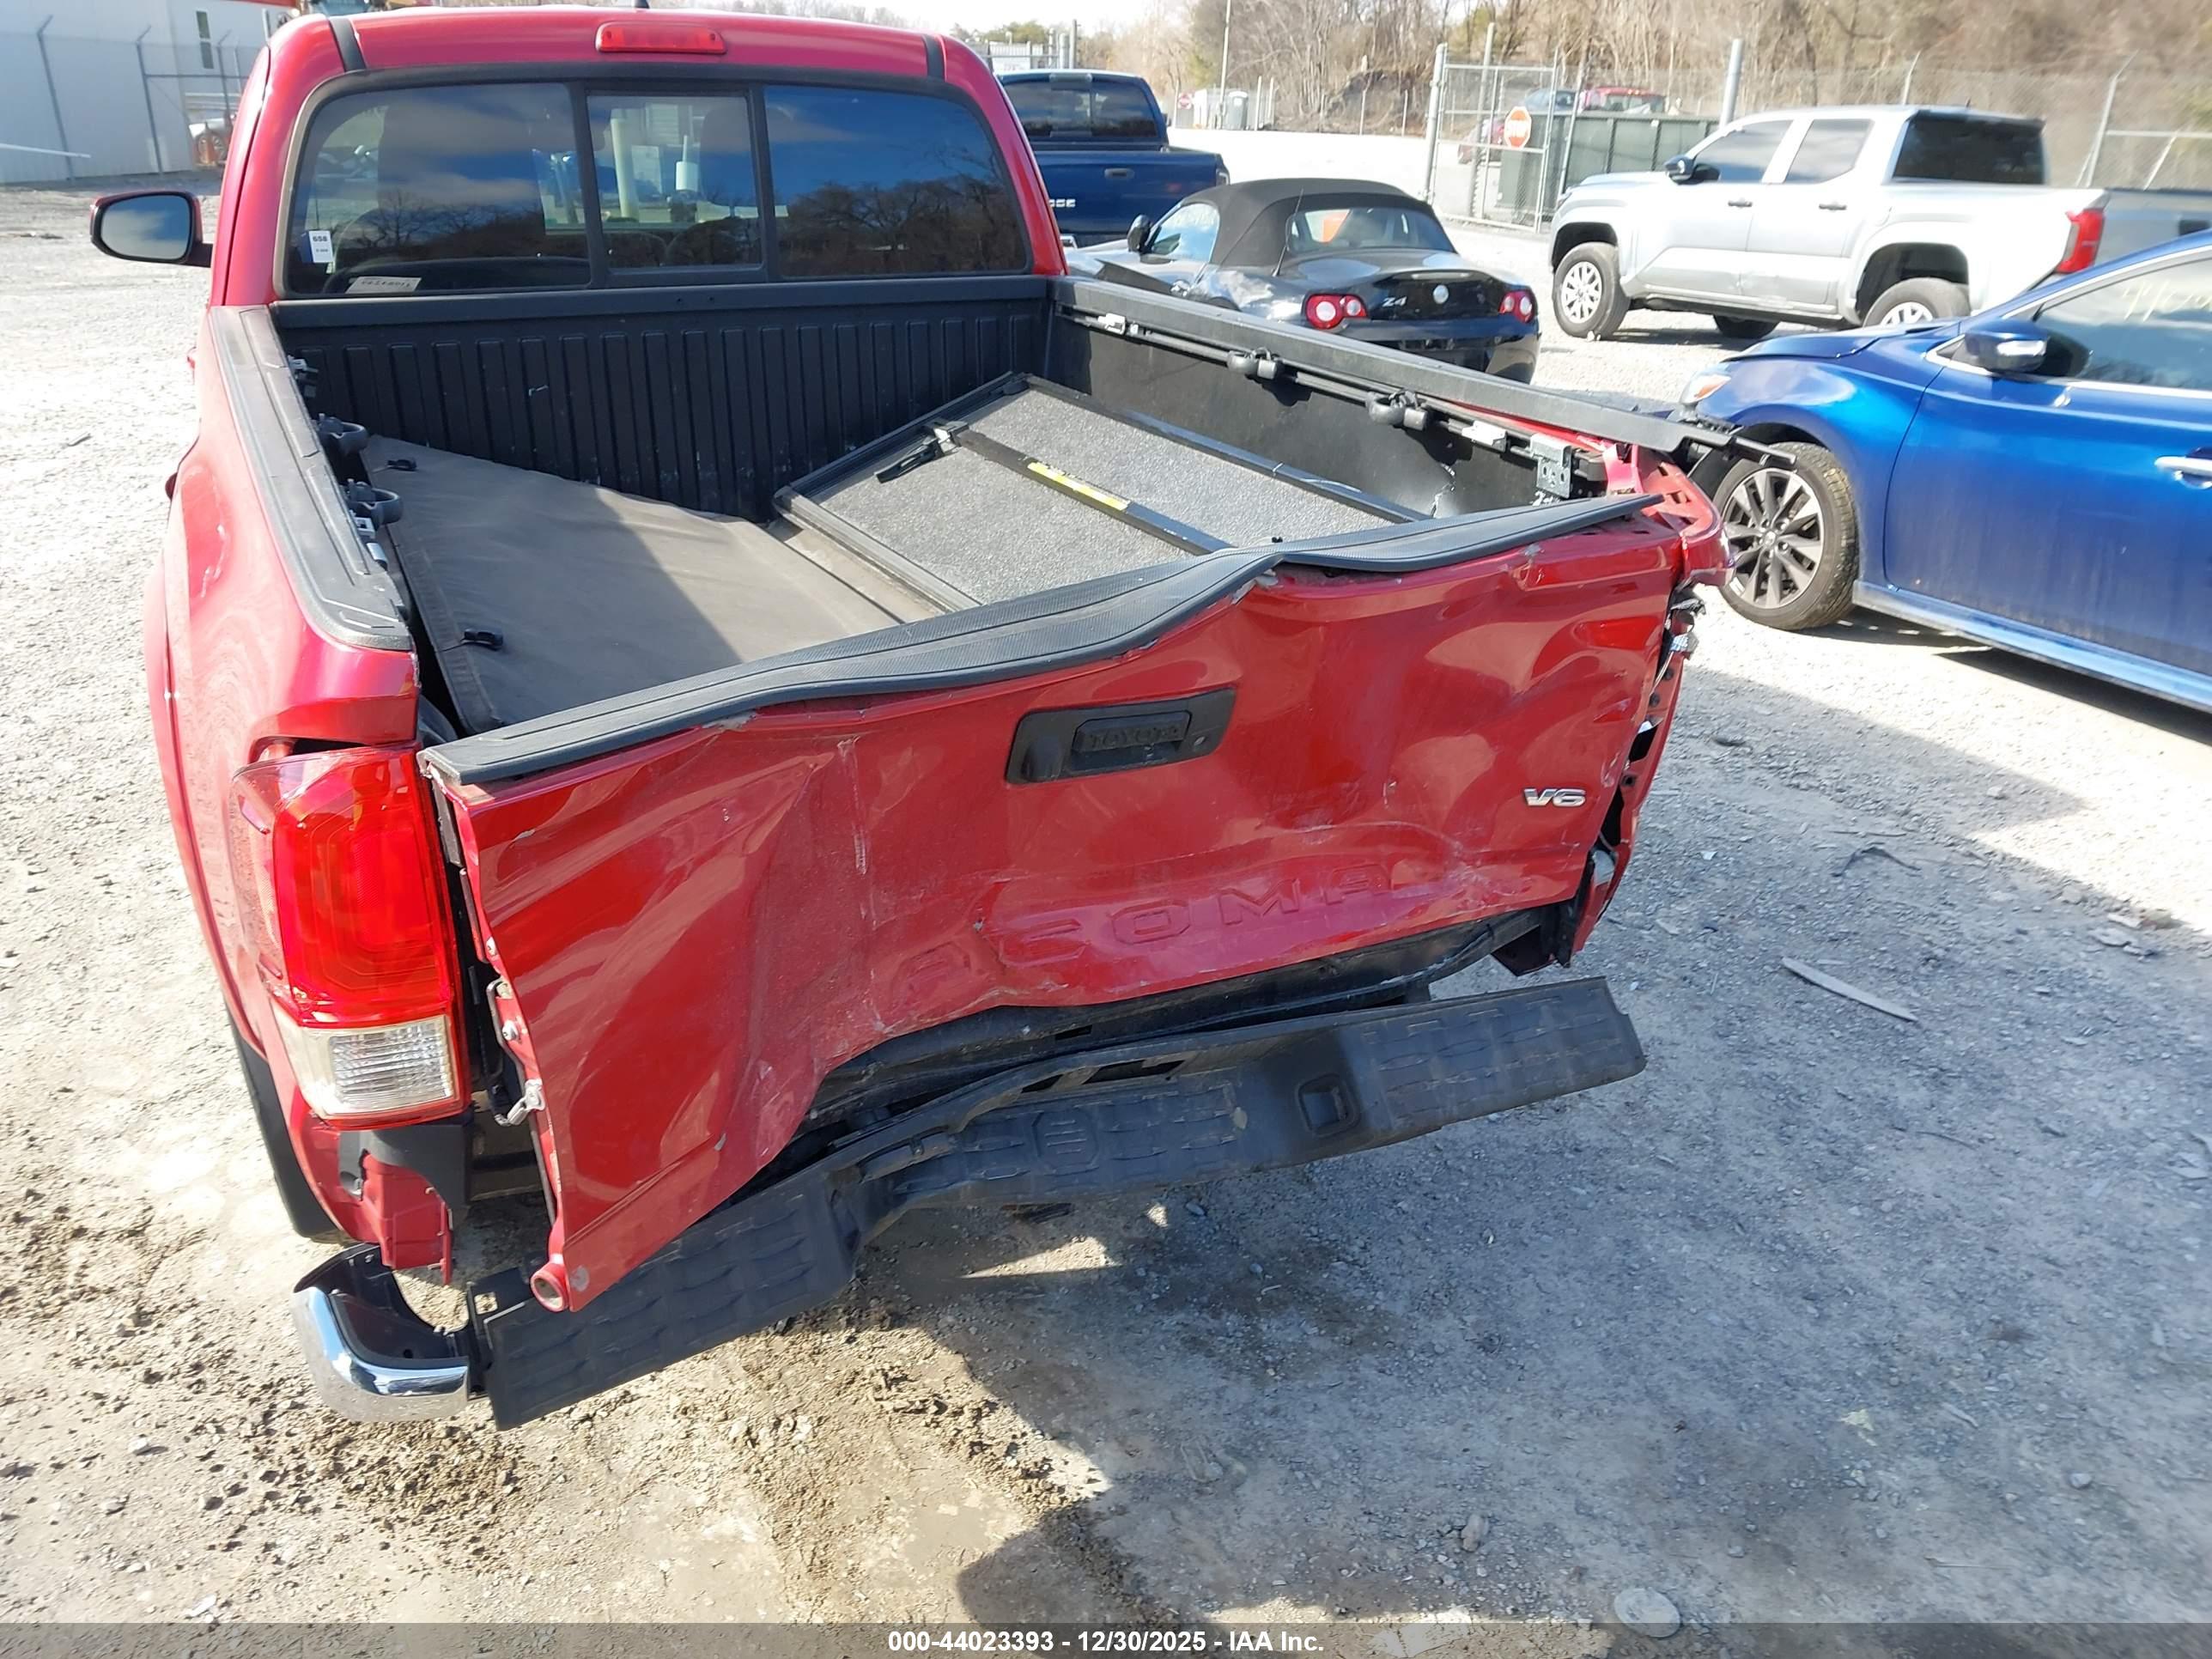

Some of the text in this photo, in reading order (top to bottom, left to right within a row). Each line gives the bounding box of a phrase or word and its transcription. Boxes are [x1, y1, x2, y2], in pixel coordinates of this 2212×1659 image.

[1382, 296, 1407, 307] Z4
[1523, 787, 1586, 807] V6
[888, 862, 1395, 1010] ACOMA
